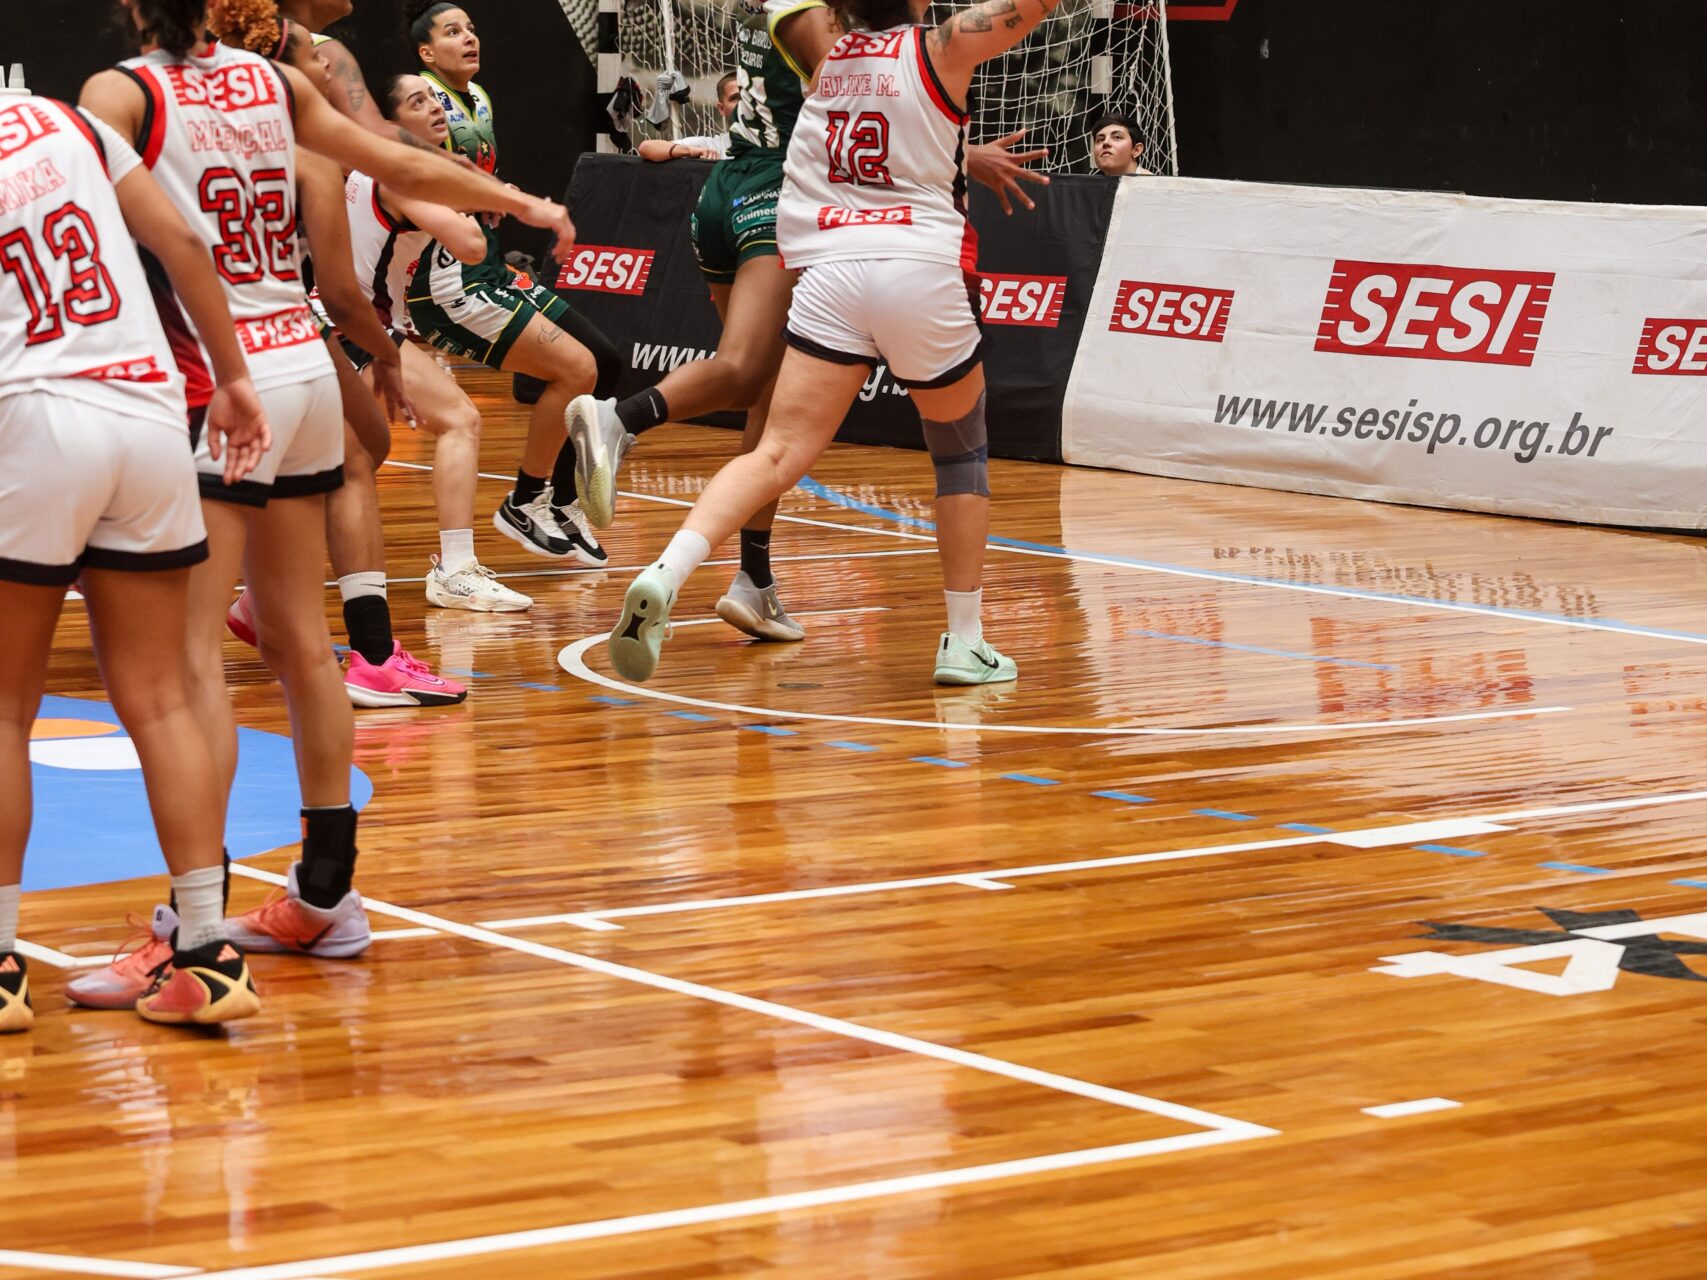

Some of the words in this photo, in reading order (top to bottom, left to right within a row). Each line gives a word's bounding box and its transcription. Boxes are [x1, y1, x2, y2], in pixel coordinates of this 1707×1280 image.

[829, 30, 902, 58] SESI
[182, 66, 269, 110] SESI
[820, 74, 872, 98] ALINE
[875, 73, 901, 97] M.
[0, 104, 44, 153] SI
[825, 110, 895, 187] 12
[198, 167, 299, 286] 32
[0, 201, 121, 347] 13
[566, 250, 646, 290] SESI
[979, 278, 1057, 321] SESI
[1121, 288, 1220, 336] SESI
[1337, 274, 1532, 355] SESI
[1213, 393, 1614, 464] www.sesisp.org.br
